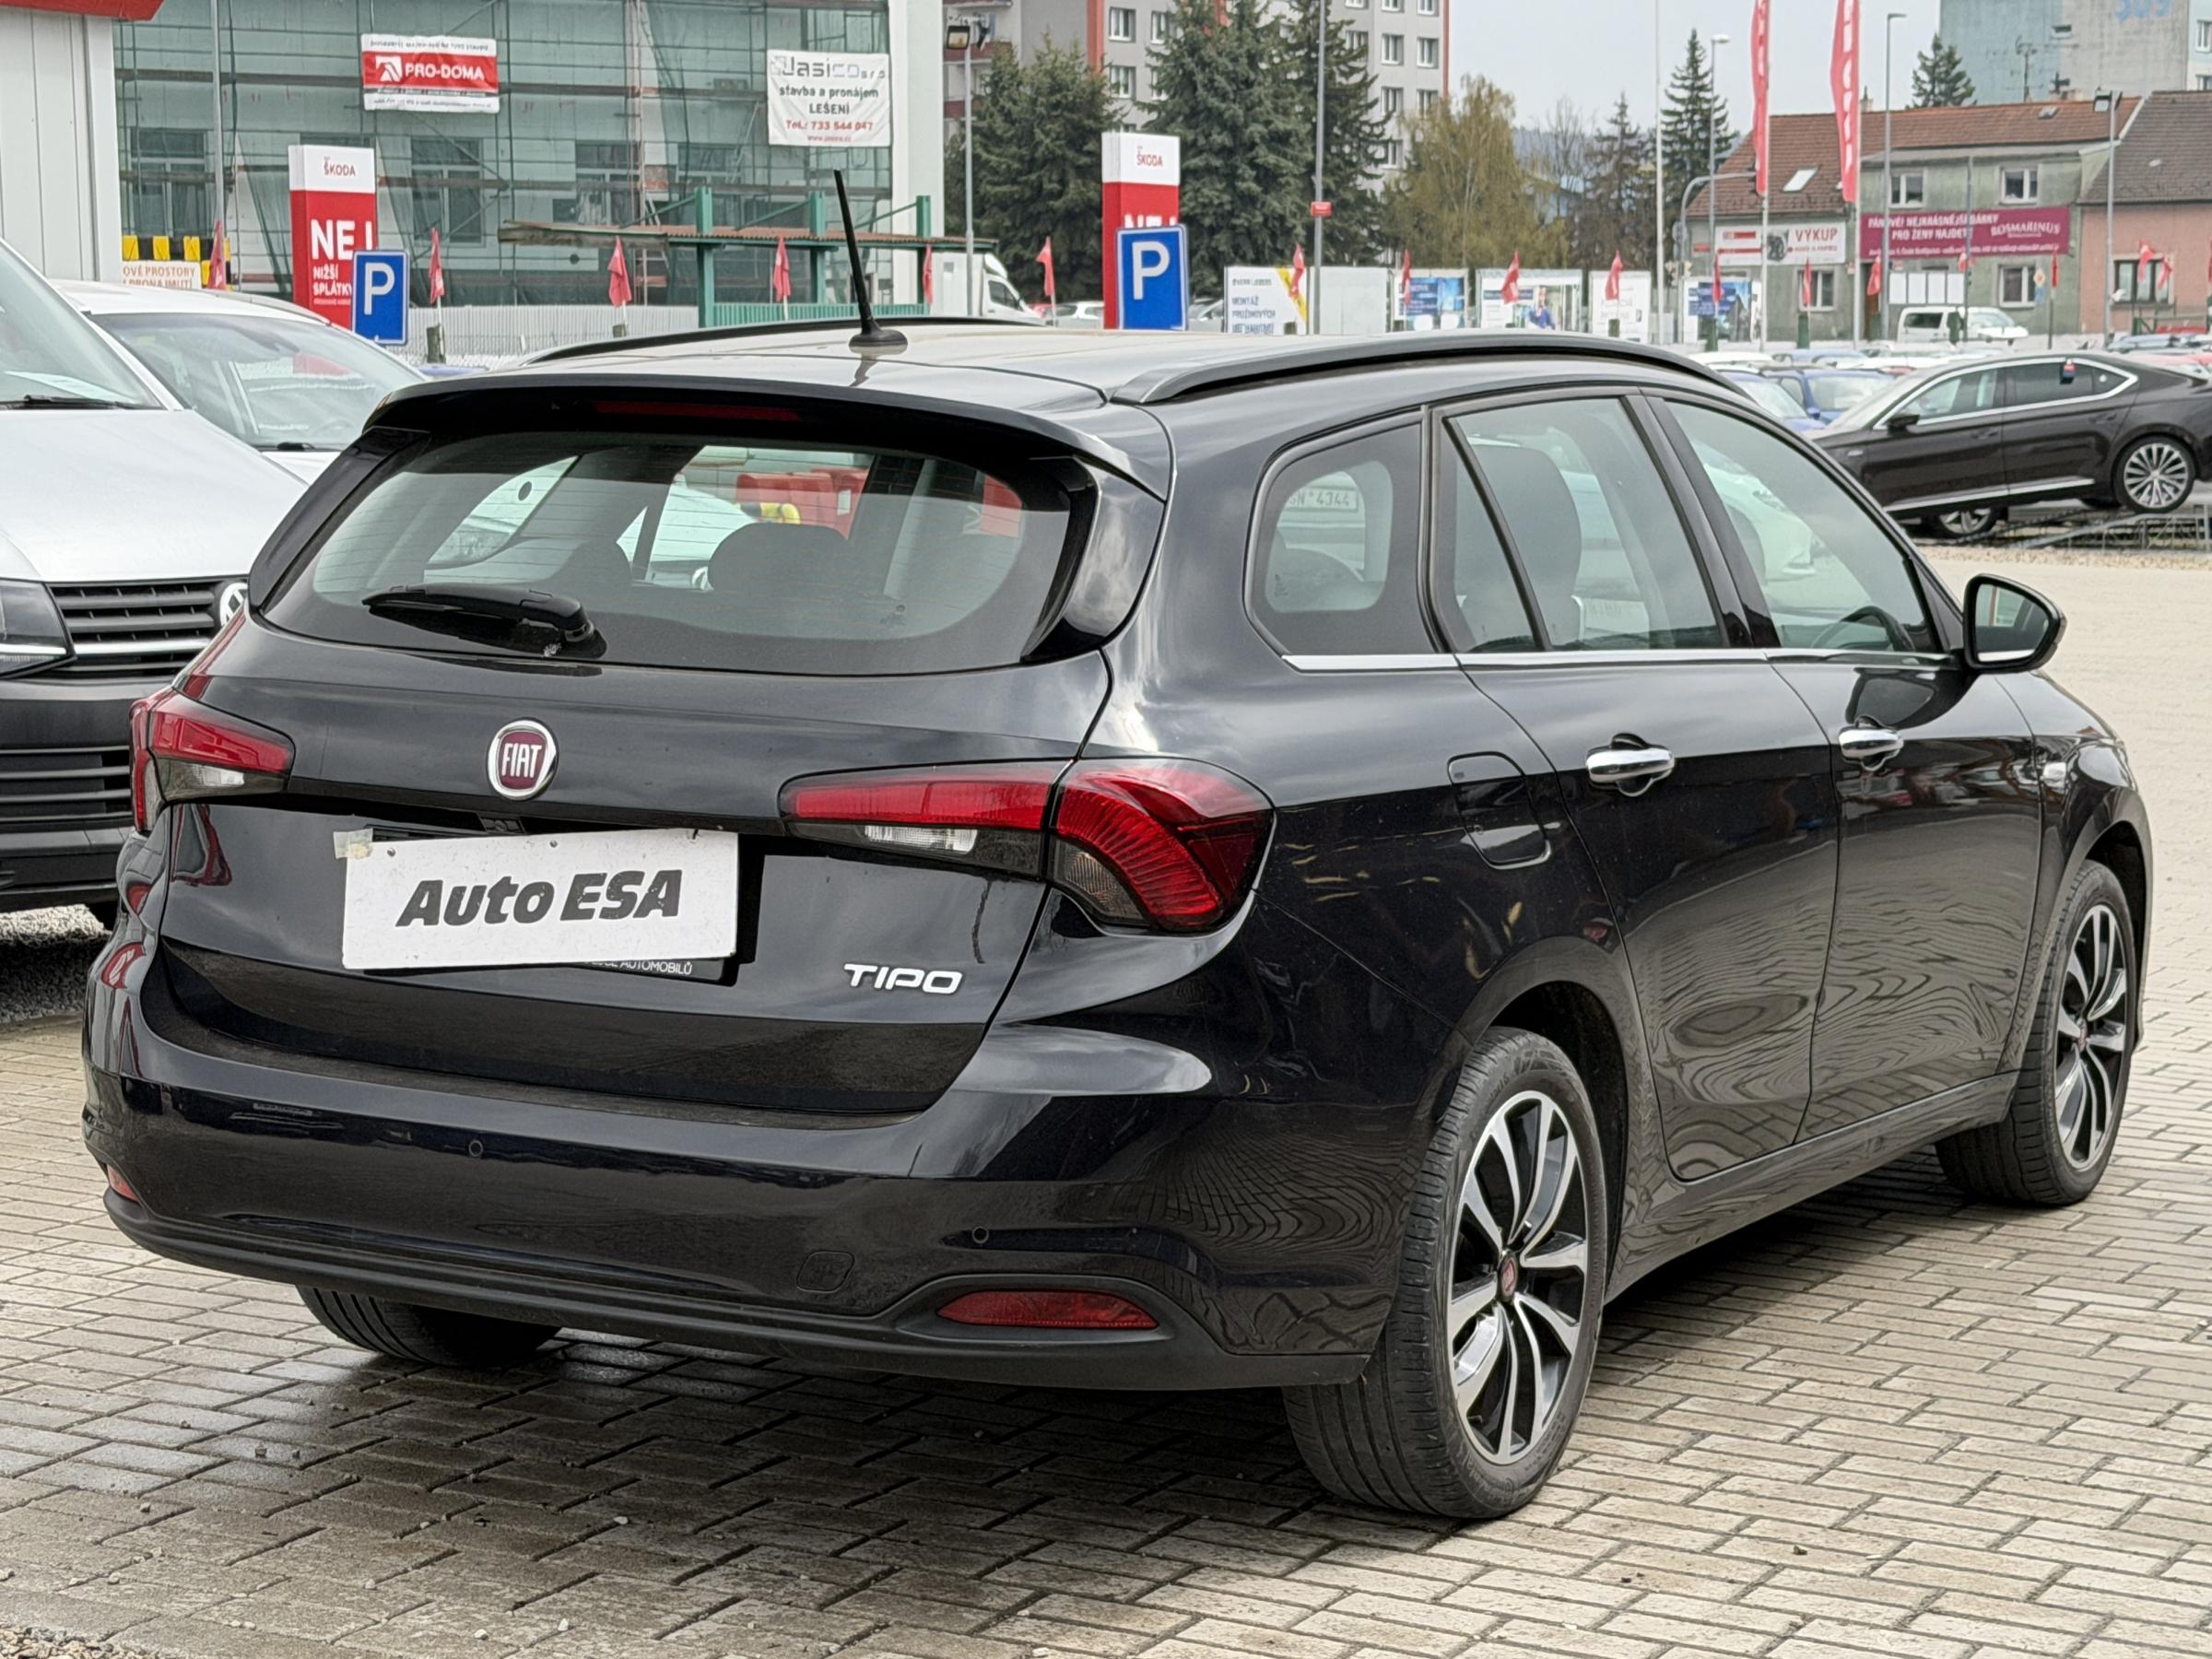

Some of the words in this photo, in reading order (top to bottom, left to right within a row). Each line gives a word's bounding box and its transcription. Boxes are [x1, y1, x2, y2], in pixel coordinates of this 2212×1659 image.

[405, 63, 486, 81] PRO-DOMA
[779, 83, 816, 97] stavba
[818, 88, 826, 97] a
[829, 87, 879, 100] pronájem
[809, 101, 851, 114] LEŠENÍ
[811, 122, 830, 130] 733
[1136, 153, 1163, 167] ŠKODA
[324, 161, 356, 176] ŠKODA
[1867, 216, 1905, 229] PÁNVÉ!
[1794, 228, 1838, 241] VÝKUP
[1891, 229, 1910, 240] PRO
[1936, 227, 1972, 239] NAJDET
[145, 265, 195, 276] PROSTORY
[312, 265, 339, 280] NIŽŠÍ
[1131, 241, 1171, 300] P
[363, 262, 396, 315] P
[501, 743, 543, 779] FIAT
[395, 875, 556, 928] Auto
[559, 869, 683, 922] ESA
[619, 959, 693, 976] AUTOMOBILŮ
[843, 963, 963, 994] TIPO
